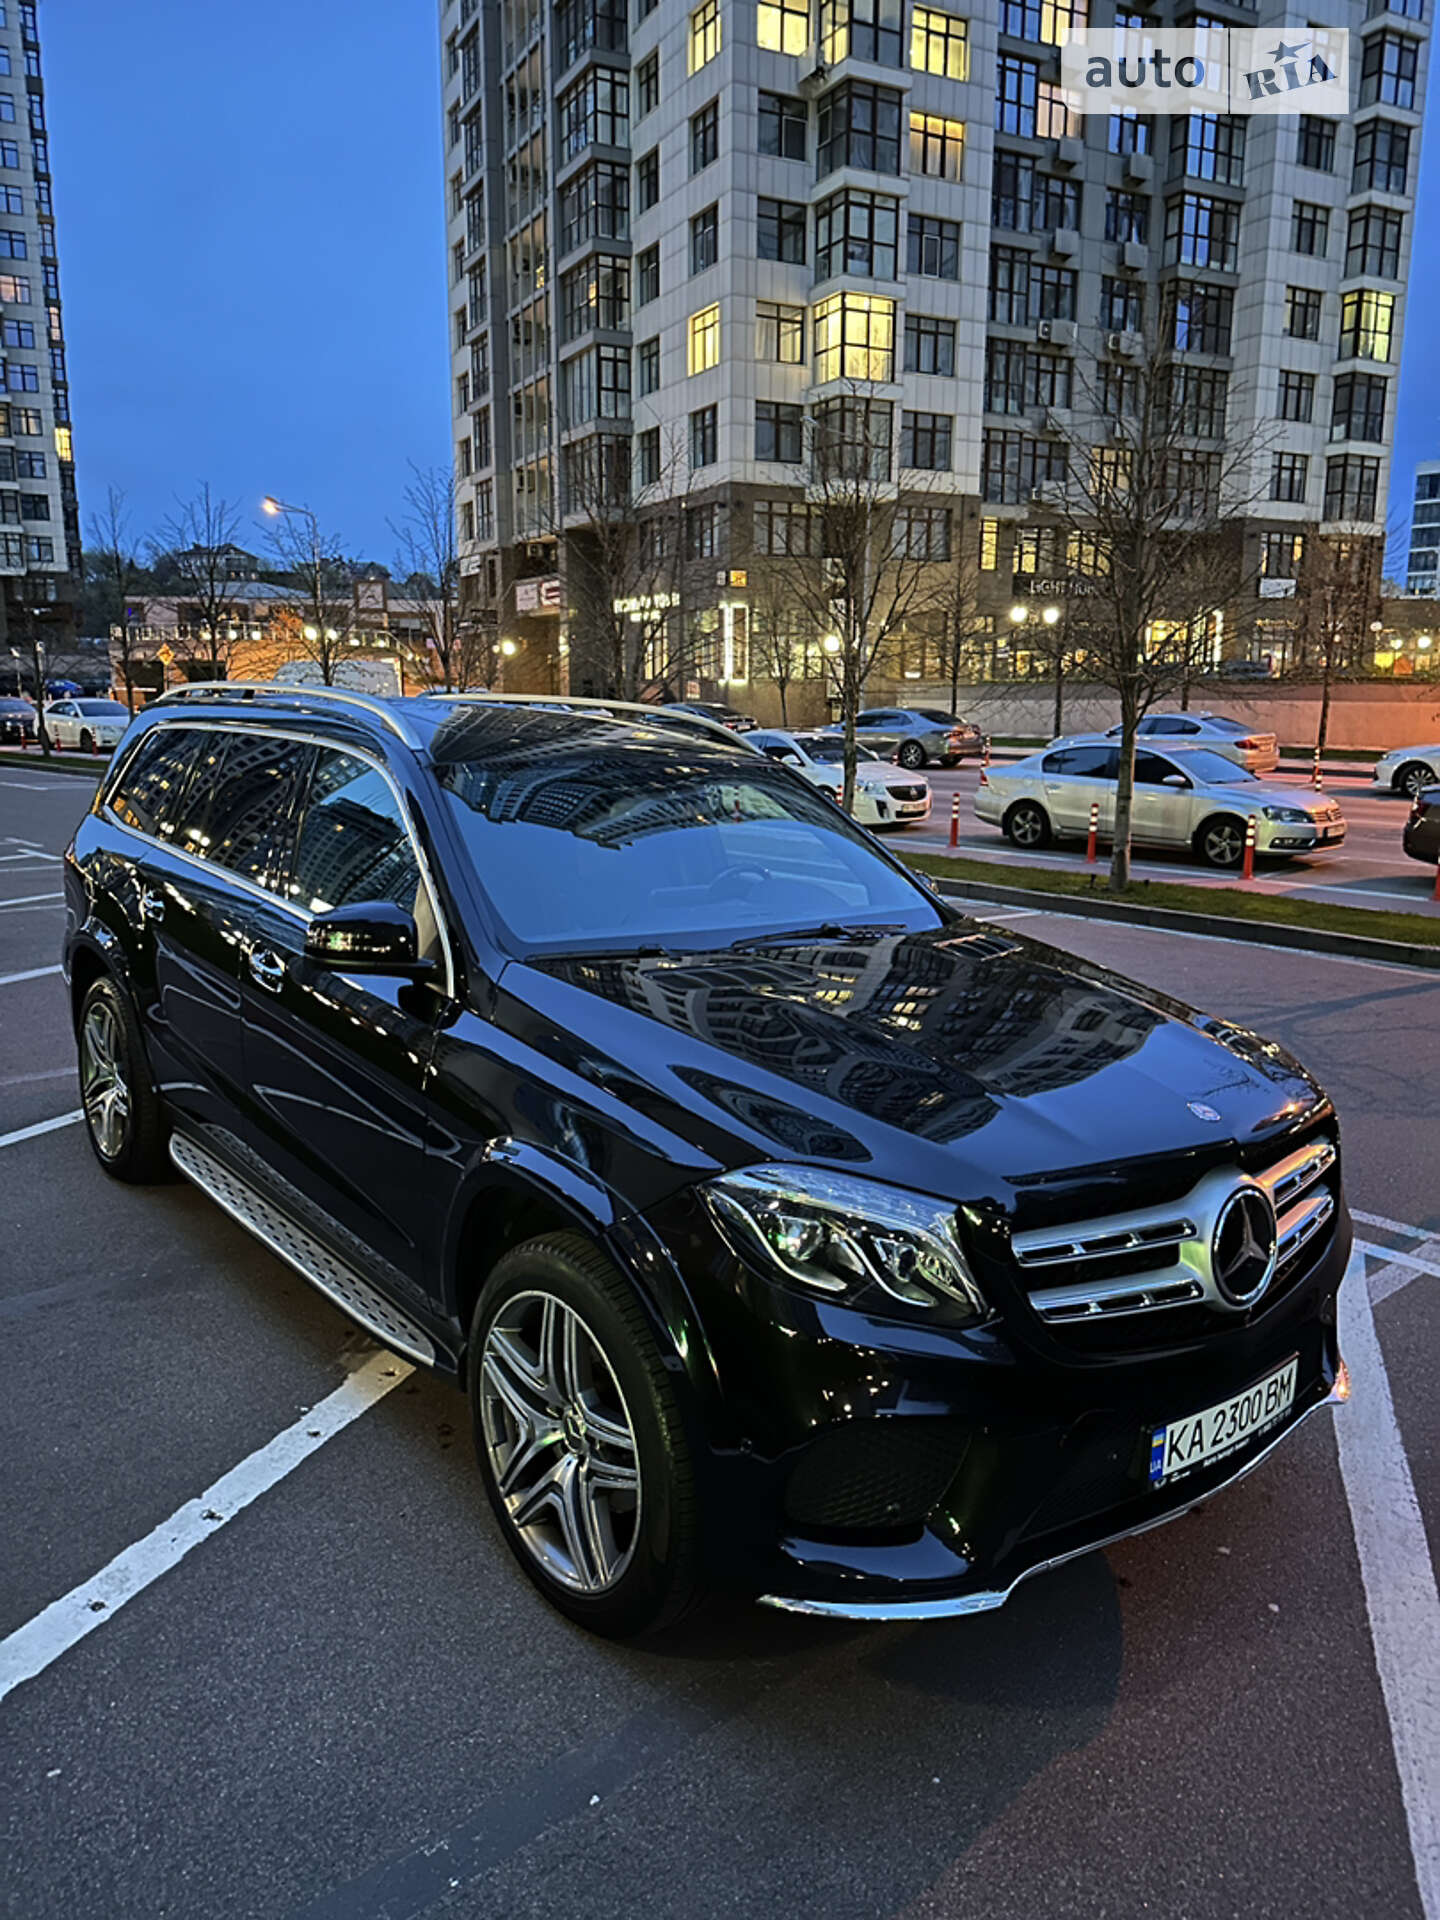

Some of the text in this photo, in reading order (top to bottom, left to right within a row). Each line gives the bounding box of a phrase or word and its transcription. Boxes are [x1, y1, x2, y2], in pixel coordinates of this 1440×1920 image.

[1167, 1418, 1204, 1467] KA
[1211, 1390, 1262, 1447] 2300
[1265, 1367, 1294, 1416] BM
